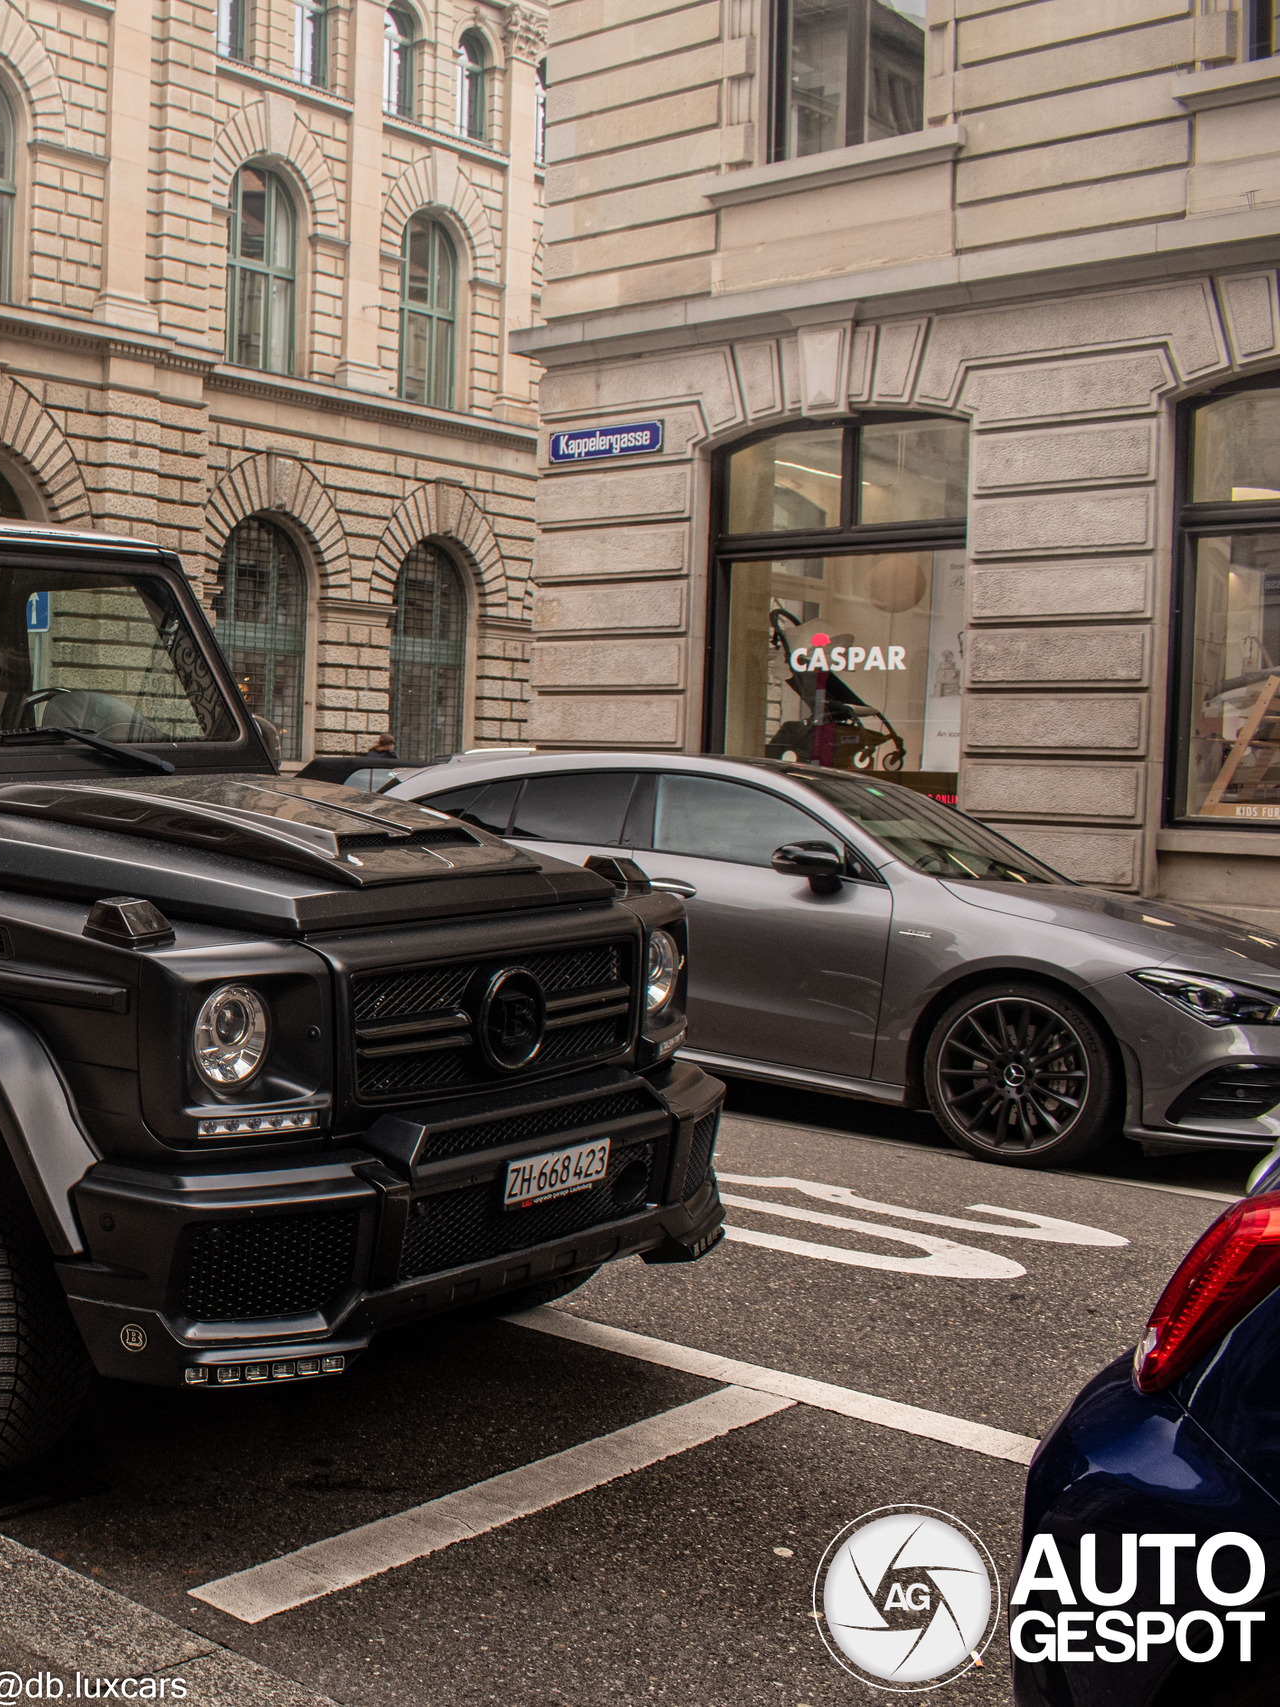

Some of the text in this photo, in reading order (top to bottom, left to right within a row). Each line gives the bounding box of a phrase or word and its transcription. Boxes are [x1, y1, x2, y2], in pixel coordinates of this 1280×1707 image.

[559, 430, 651, 458] Kappelergasse
[790, 646, 907, 672] CASPAR
[1236, 806, 1258, 817] KIDS
